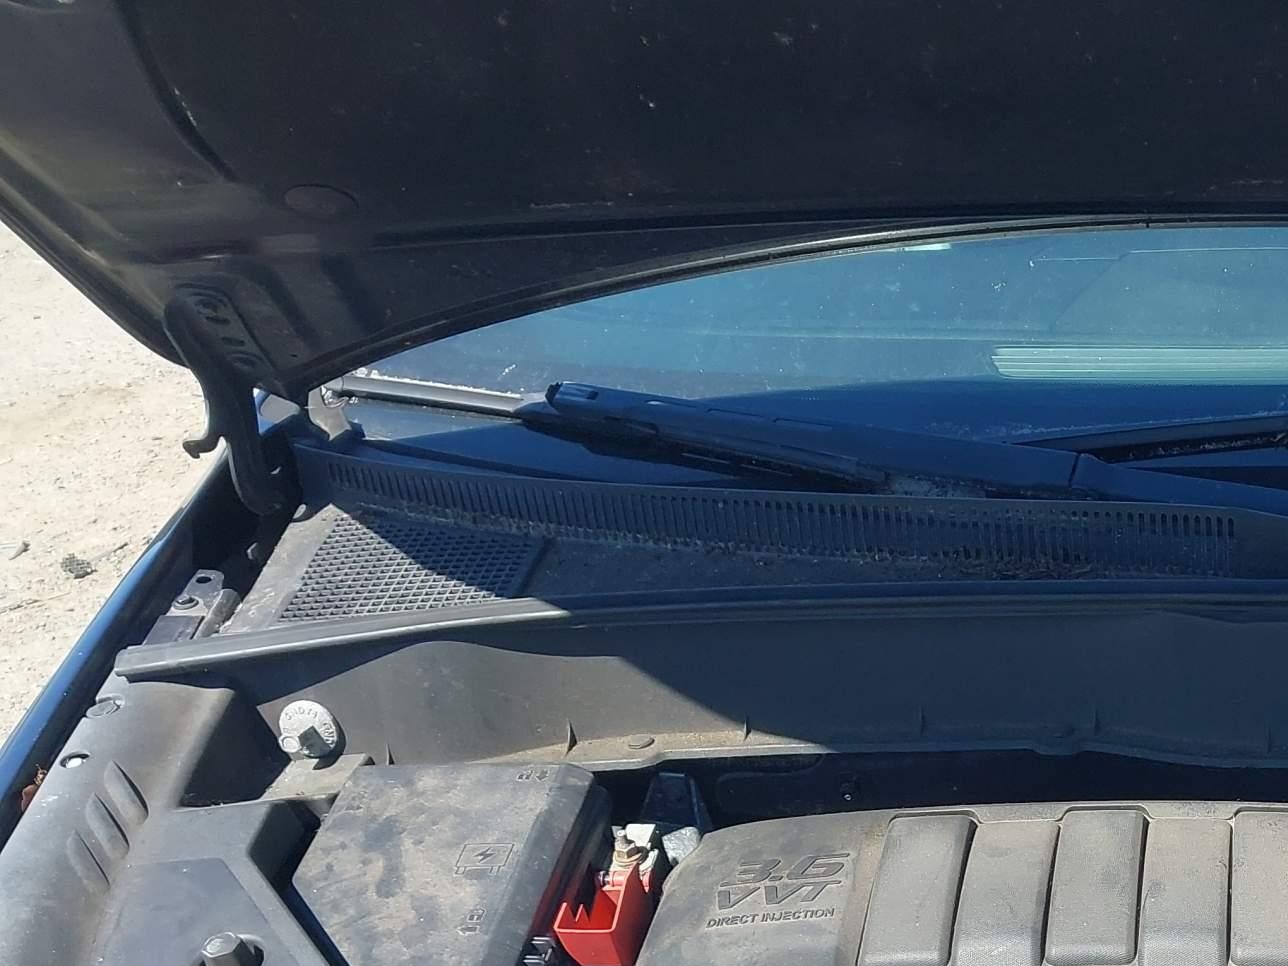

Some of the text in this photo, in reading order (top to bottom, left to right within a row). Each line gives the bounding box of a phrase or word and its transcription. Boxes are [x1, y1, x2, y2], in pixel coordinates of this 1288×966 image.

[736, 852, 850, 883] 3.6
[717, 880, 842, 910] VVT
[706, 907, 835, 929] DIRECT INJECTION
